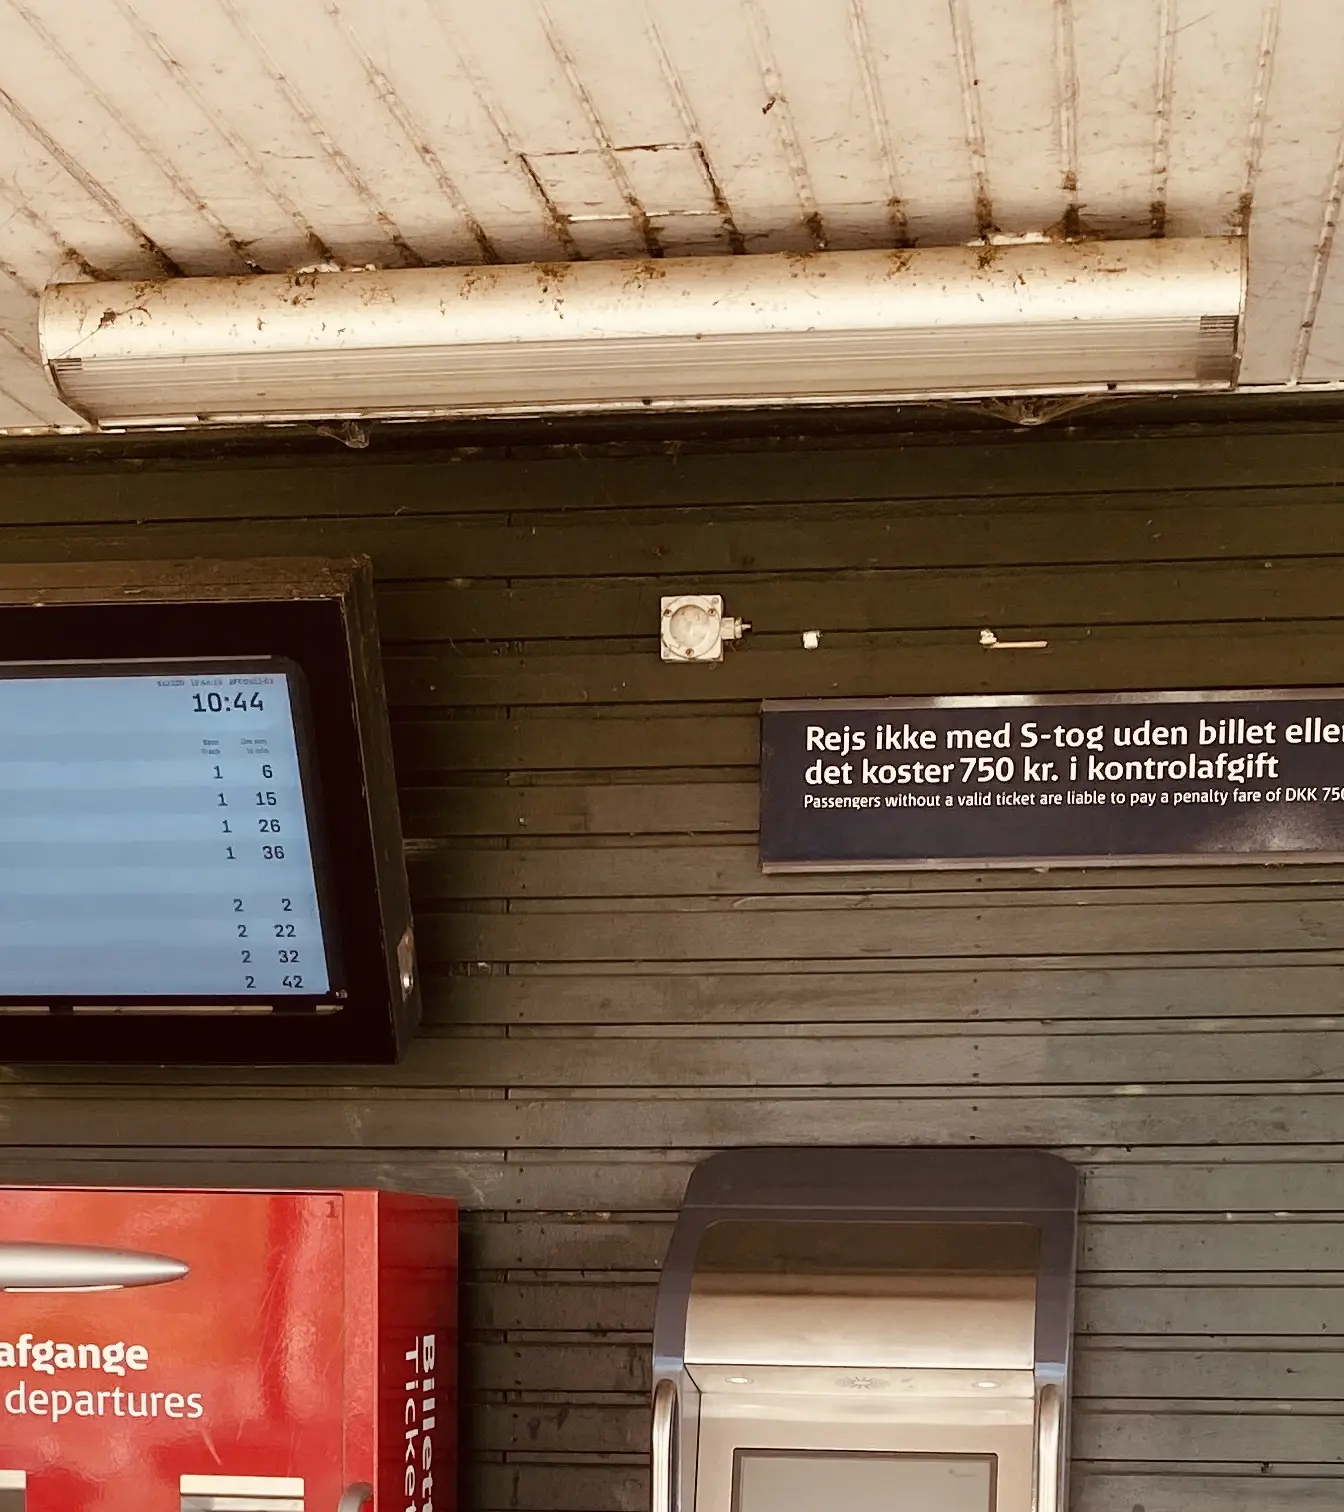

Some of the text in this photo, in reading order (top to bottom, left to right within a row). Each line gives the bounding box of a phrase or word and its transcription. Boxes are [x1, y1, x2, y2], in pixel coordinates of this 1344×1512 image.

[192, 691, 264, 713] 10:44
[805, 725, 866, 756] Rejs
[875, 724, 937, 750] ikke
[946, 722, 1011, 749] med
[1020, 722, 1104, 751] S-tog
[1113, 719, 1188, 747] uden
[1198, 718, 1276, 746] billet
[213, 765, 224, 779] 1
[262, 764, 273, 779] 6
[804, 752, 1279, 785] det koster 750 kr. i kontrolafgift
[217, 792, 228, 806] 1
[255, 791, 277, 806] 15
[804, 794, 881, 810] Passengers
[884, 792, 941, 808] without
[944, 795, 954, 807] a
[957, 791, 992, 807] valid
[996, 790, 1036, 806] ticket
[1039, 793, 1063, 806] are
[1066, 789, 1106, 806] liable
[1110, 790, 1126, 805] to
[1130, 791, 1157, 807] pay
[1160, 791, 1169, 804] a
[1173, 787, 1229, 806] penalty
[1232, 787, 1261, 803] fare
[1265, 787, 1282, 802] of
[1285, 787, 1318, 802] DKK
[222, 819, 232, 833] 1
[258, 819, 281, 833] 26
[226, 846, 236, 860] 1
[262, 845, 285, 860] 36
[233, 898, 244, 912] 2
[281, 898, 293, 911] 2
[237, 924, 248, 938] 2
[273, 924, 297, 938] 22
[241, 949, 252, 963] 2
[277, 949, 301, 963] 32
[245, 975, 256, 989] 2
[282, 975, 304, 989] 42
[4, 1381, 204, 1422] departures
